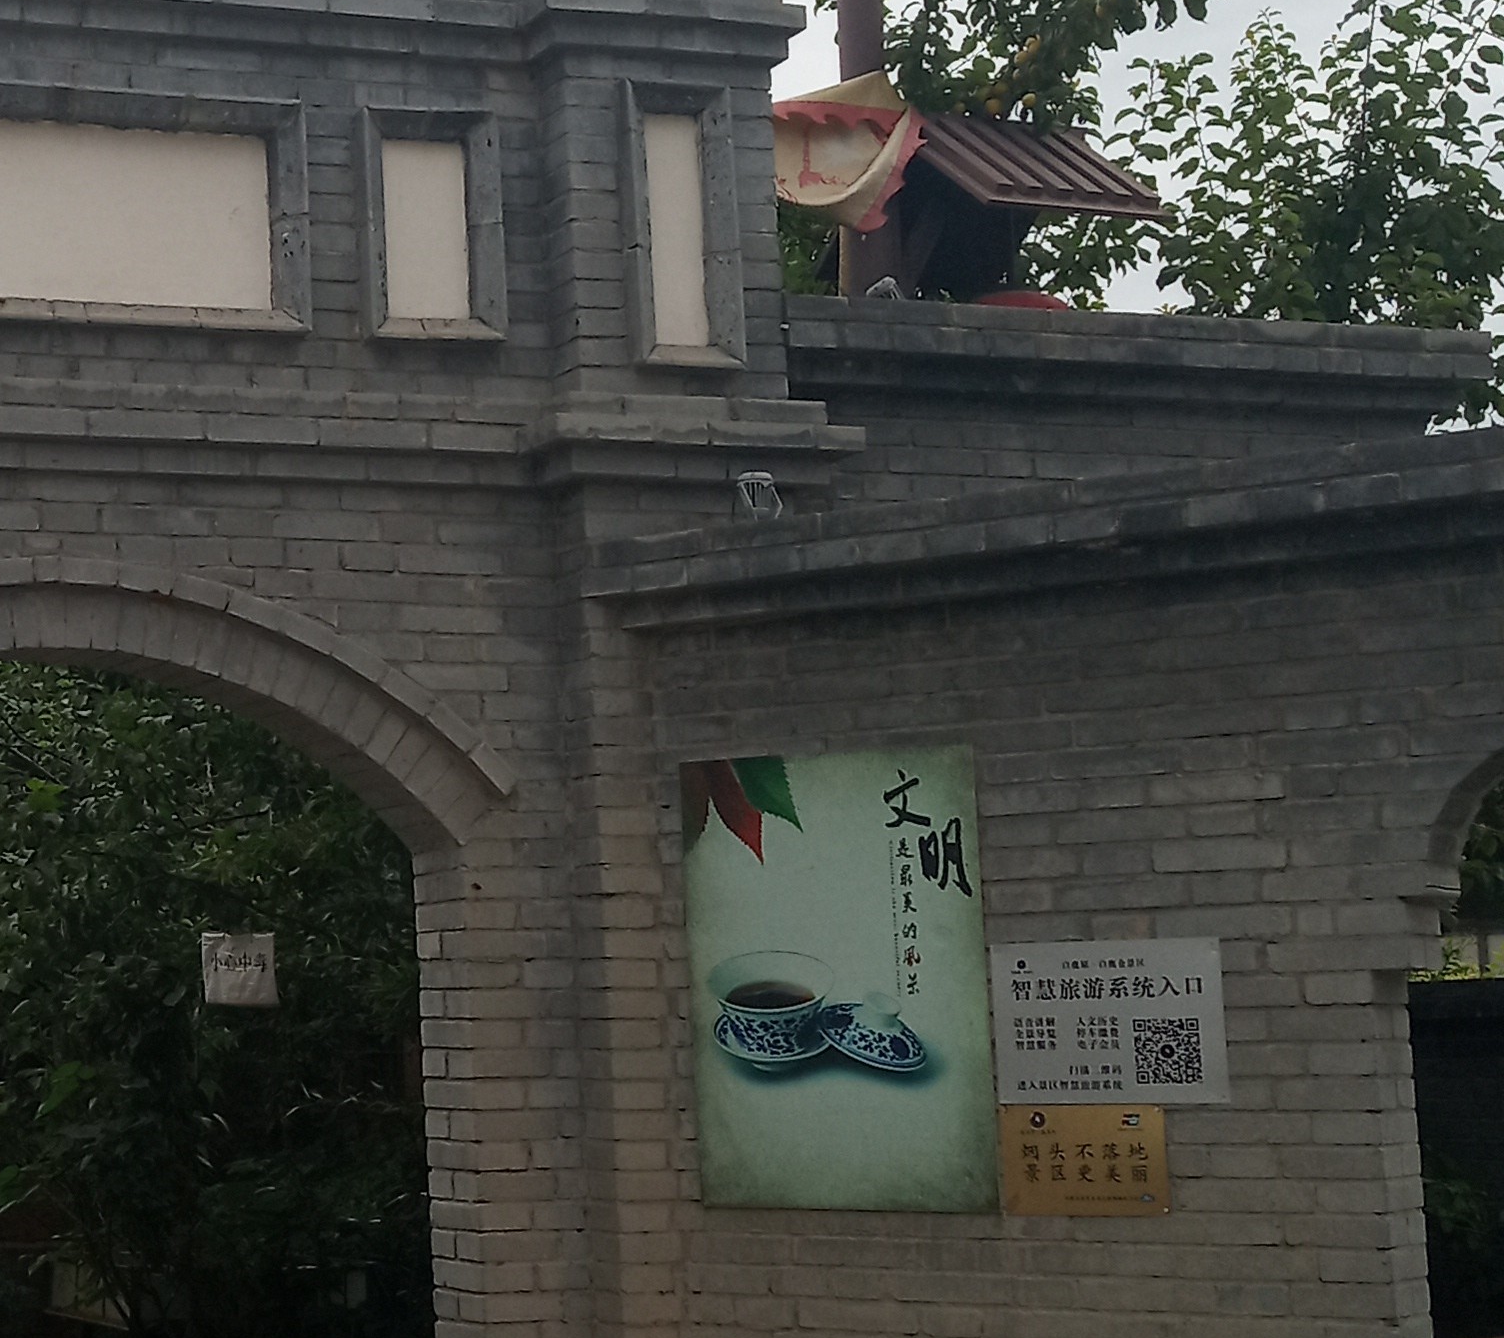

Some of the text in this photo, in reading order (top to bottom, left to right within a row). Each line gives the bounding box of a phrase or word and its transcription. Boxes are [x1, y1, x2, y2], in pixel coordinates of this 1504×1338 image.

[883, 768, 973, 898] 文明
[1011, 976, 1203, 1001] 智慧旅游系统入口
